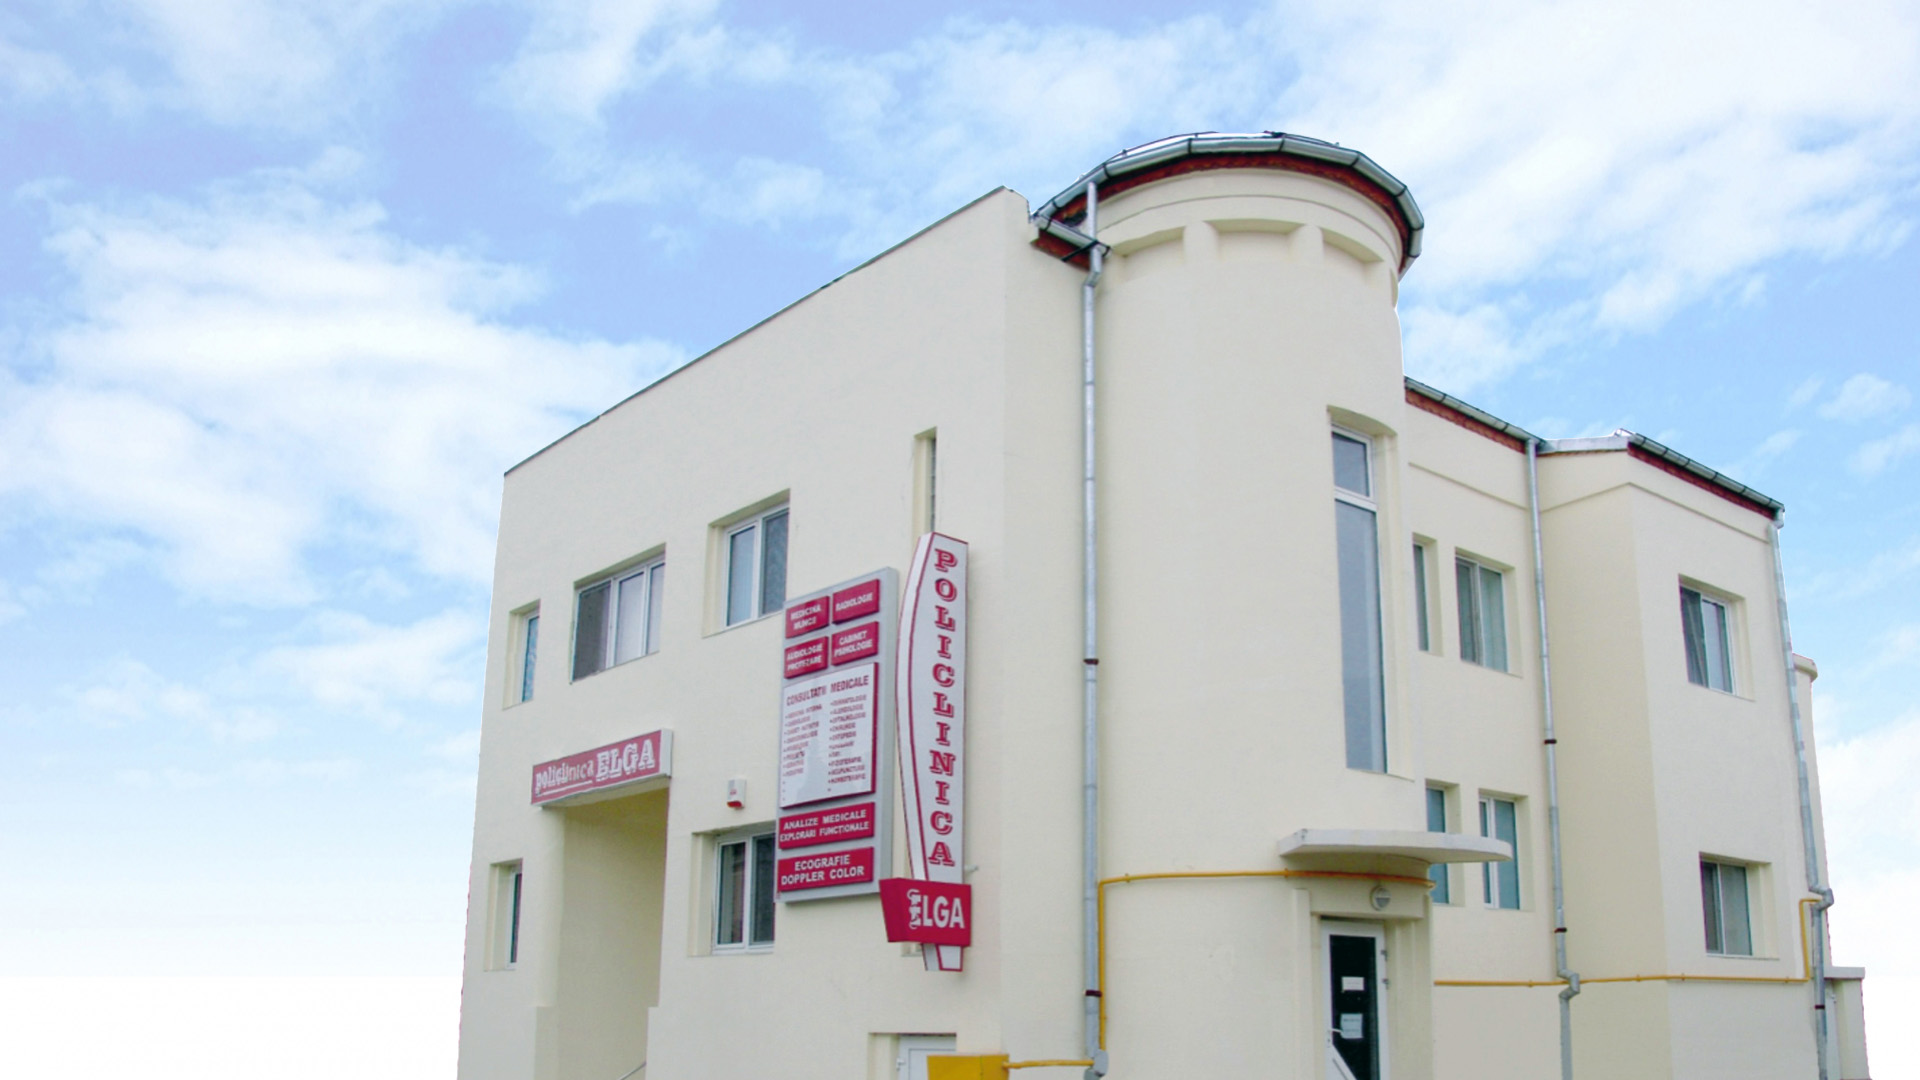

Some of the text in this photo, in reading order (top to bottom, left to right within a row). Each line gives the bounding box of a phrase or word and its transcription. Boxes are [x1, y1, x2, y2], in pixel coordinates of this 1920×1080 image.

[831, 675, 869, 693] MEDICALE
[927, 549, 958, 867] POLICLINICA
[595, 738, 656, 782] ELGA
[783, 809, 867, 831] ANALIZE MEDICALE
[794, 854, 851, 872] ECOGRAFIE
[781, 865, 865, 886] DOPPLER COLOR
[907, 888, 966, 930] ELGA
